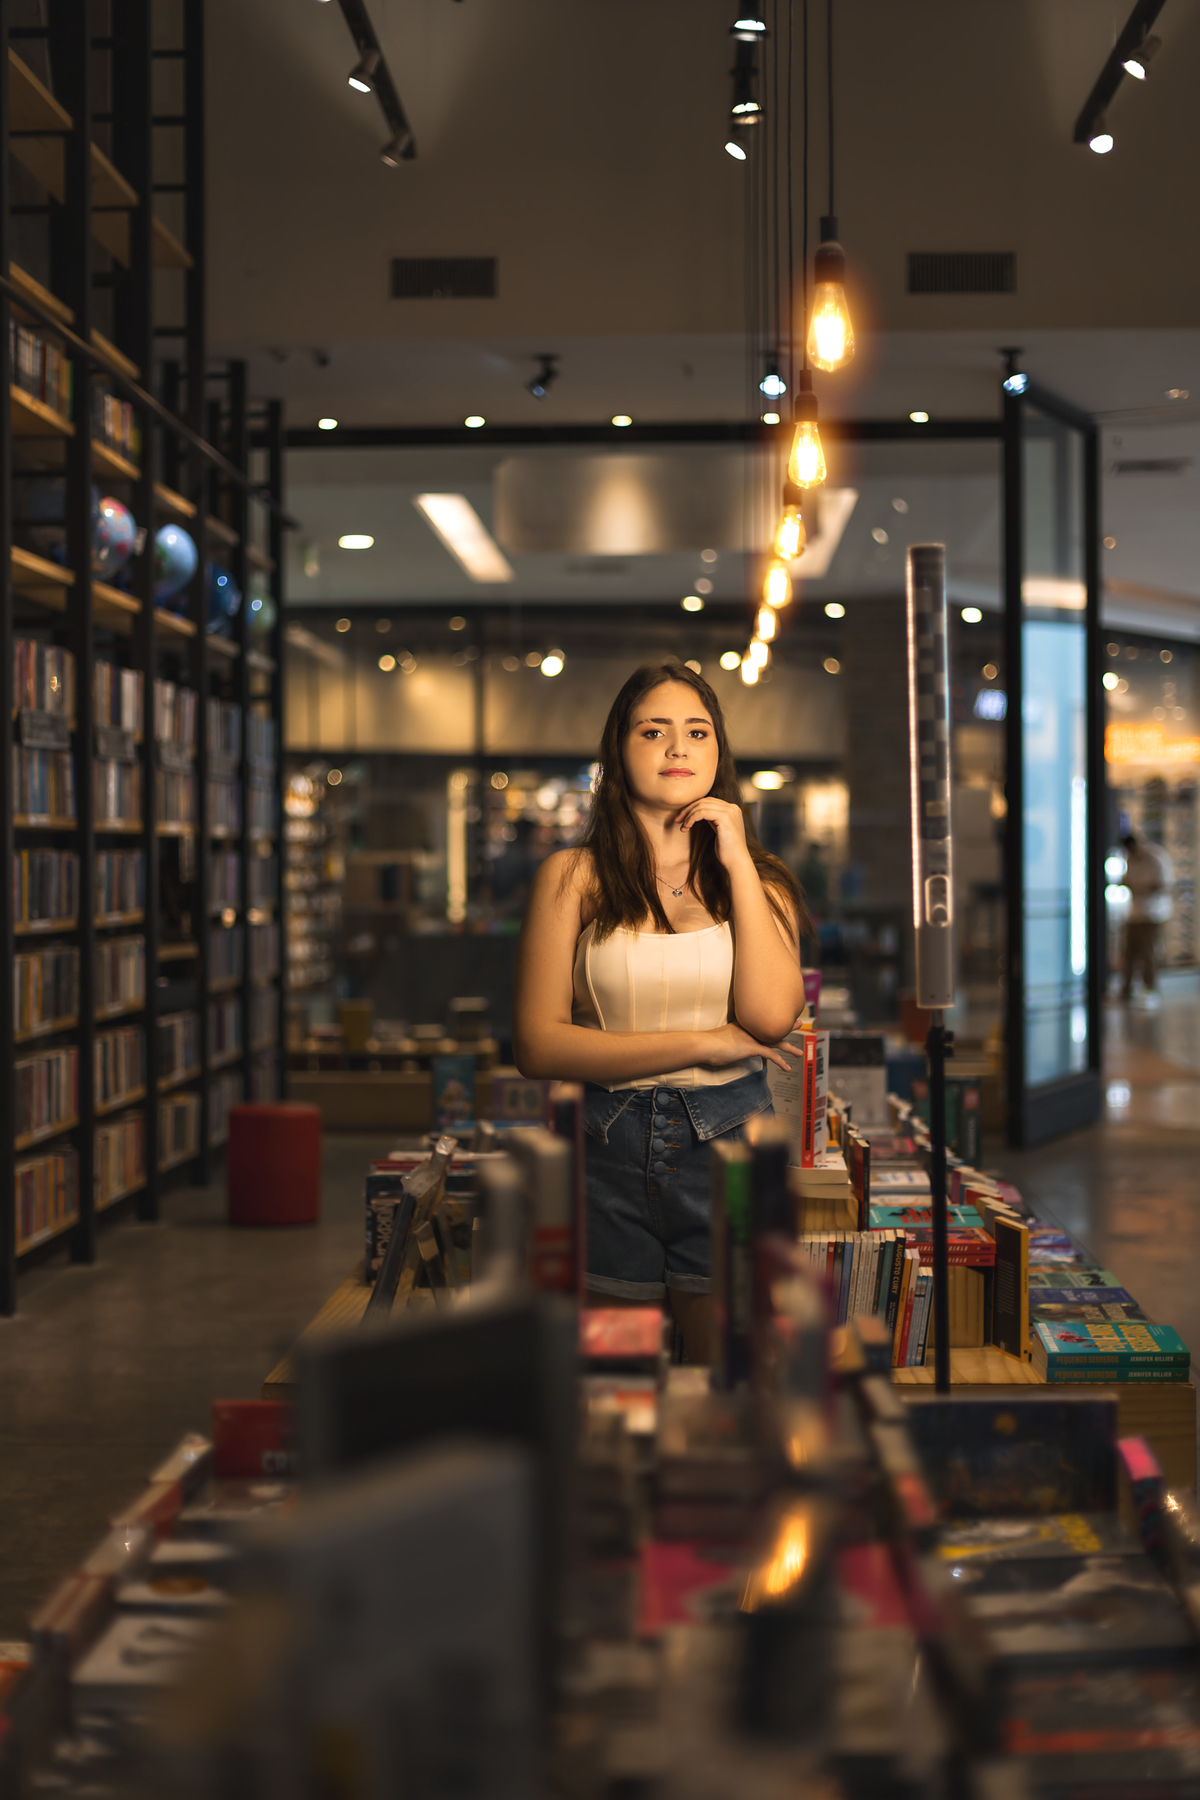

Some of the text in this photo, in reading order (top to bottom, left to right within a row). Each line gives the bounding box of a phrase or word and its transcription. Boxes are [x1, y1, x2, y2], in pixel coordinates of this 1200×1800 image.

[893, 1243, 904, 1275] AUGUSTO
[890, 1276, 900, 1295] CURY
[1056, 1356, 1087, 1365] PEQUENOS
[1054, 1371, 1086, 1380] PEQUENOS
[1087, 1371, 1117, 1379] SEGREDOS
